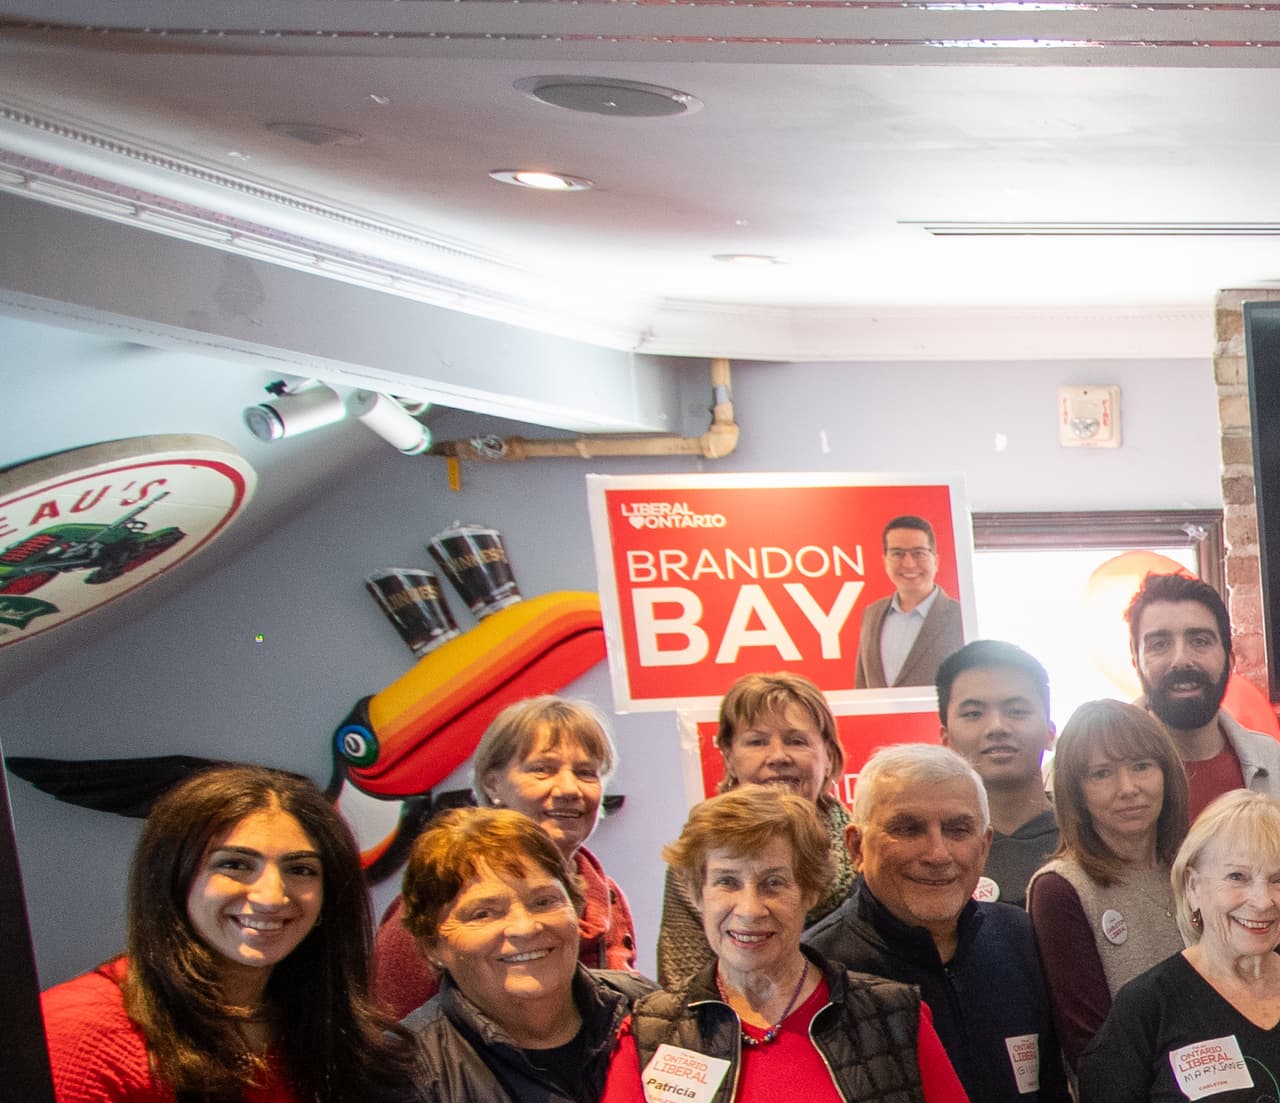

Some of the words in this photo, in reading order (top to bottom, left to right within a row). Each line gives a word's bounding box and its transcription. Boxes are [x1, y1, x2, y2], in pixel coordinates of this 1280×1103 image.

[621, 502, 694, 518] LIBERAL
[645, 514, 726, 529] ONTARIO
[626, 544, 866, 582] BRANDON
[631, 581, 866, 667] BAY
[663, 1053, 709, 1072] ONTARIO
[1179, 1052, 1233, 1072] LIBERAL
[1180, 1045, 1222, 1061] ONTARIO
[653, 1061, 708, 1084] LIBERAL
[646, 1078, 697, 1099] Patricia
